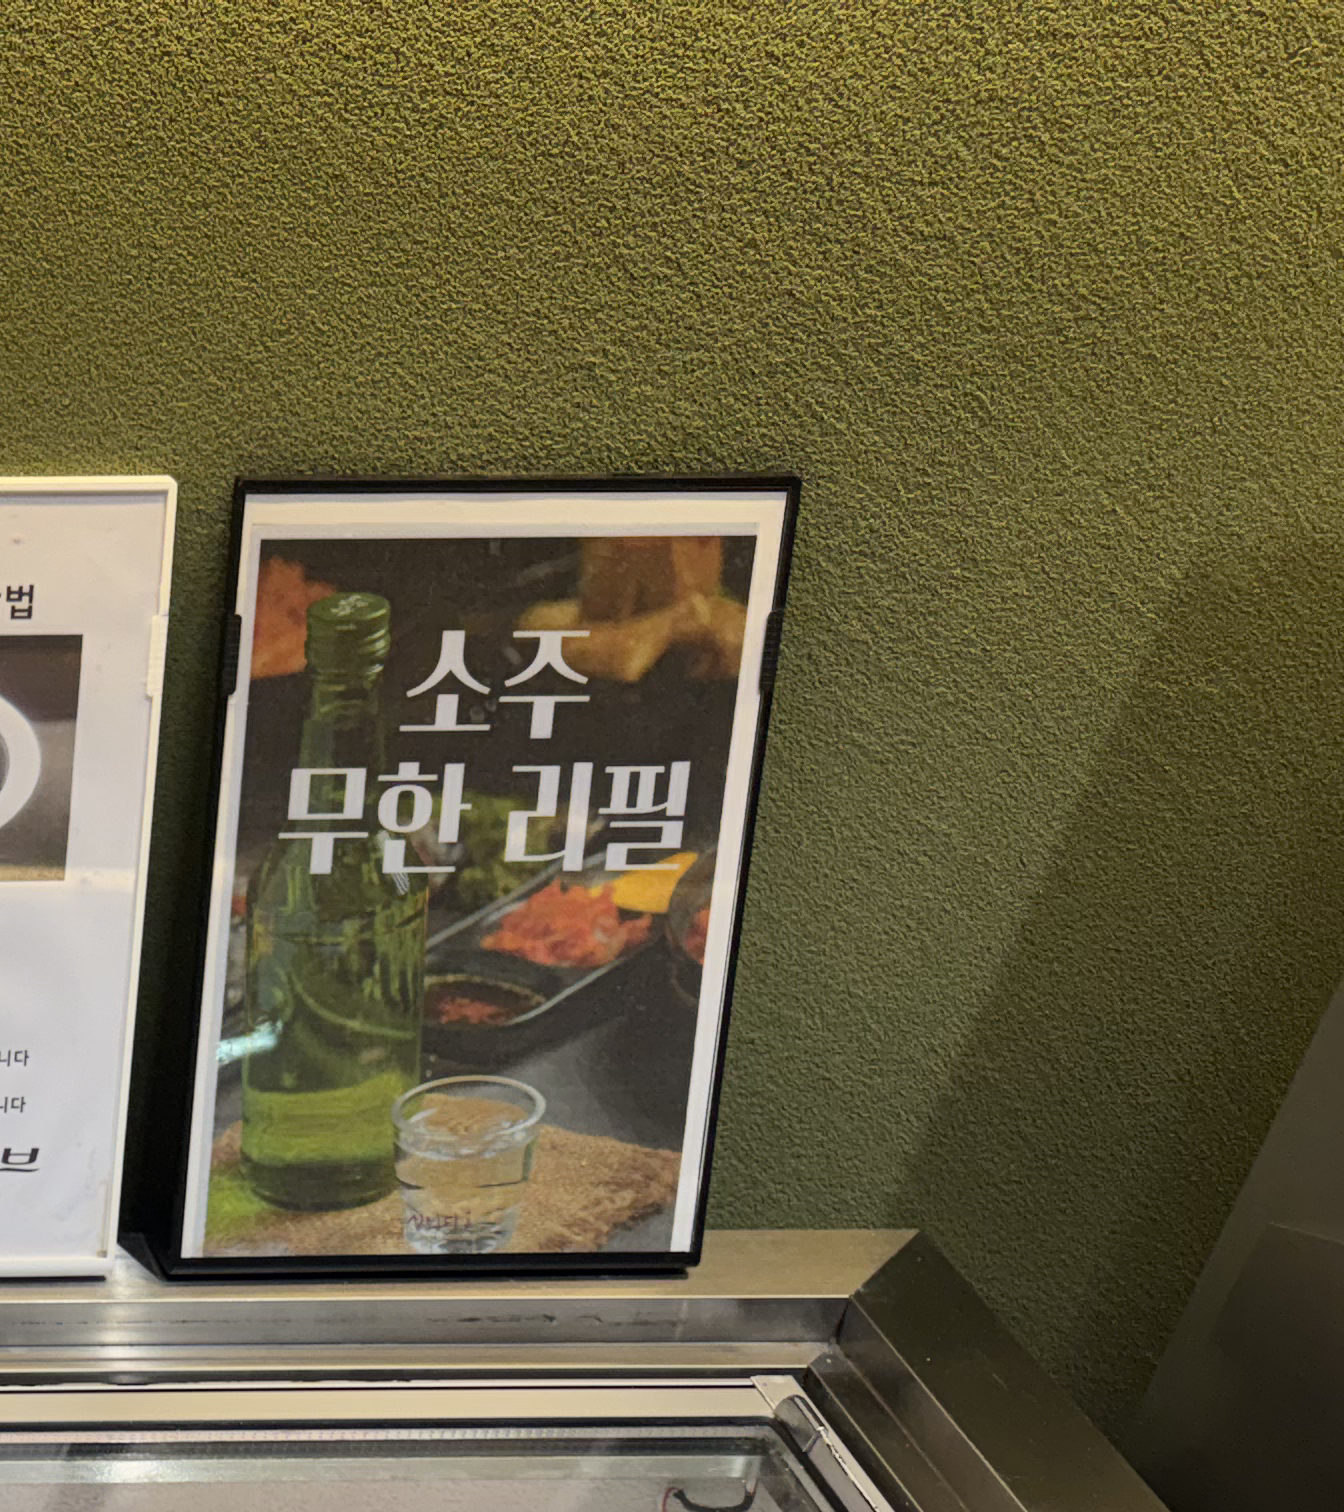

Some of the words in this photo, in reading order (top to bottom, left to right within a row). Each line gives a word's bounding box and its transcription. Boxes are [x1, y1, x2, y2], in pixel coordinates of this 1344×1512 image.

[399, 629, 591, 740] 소주
[278, 762, 472, 875] 무한
[503, 760, 691, 873] 리필
